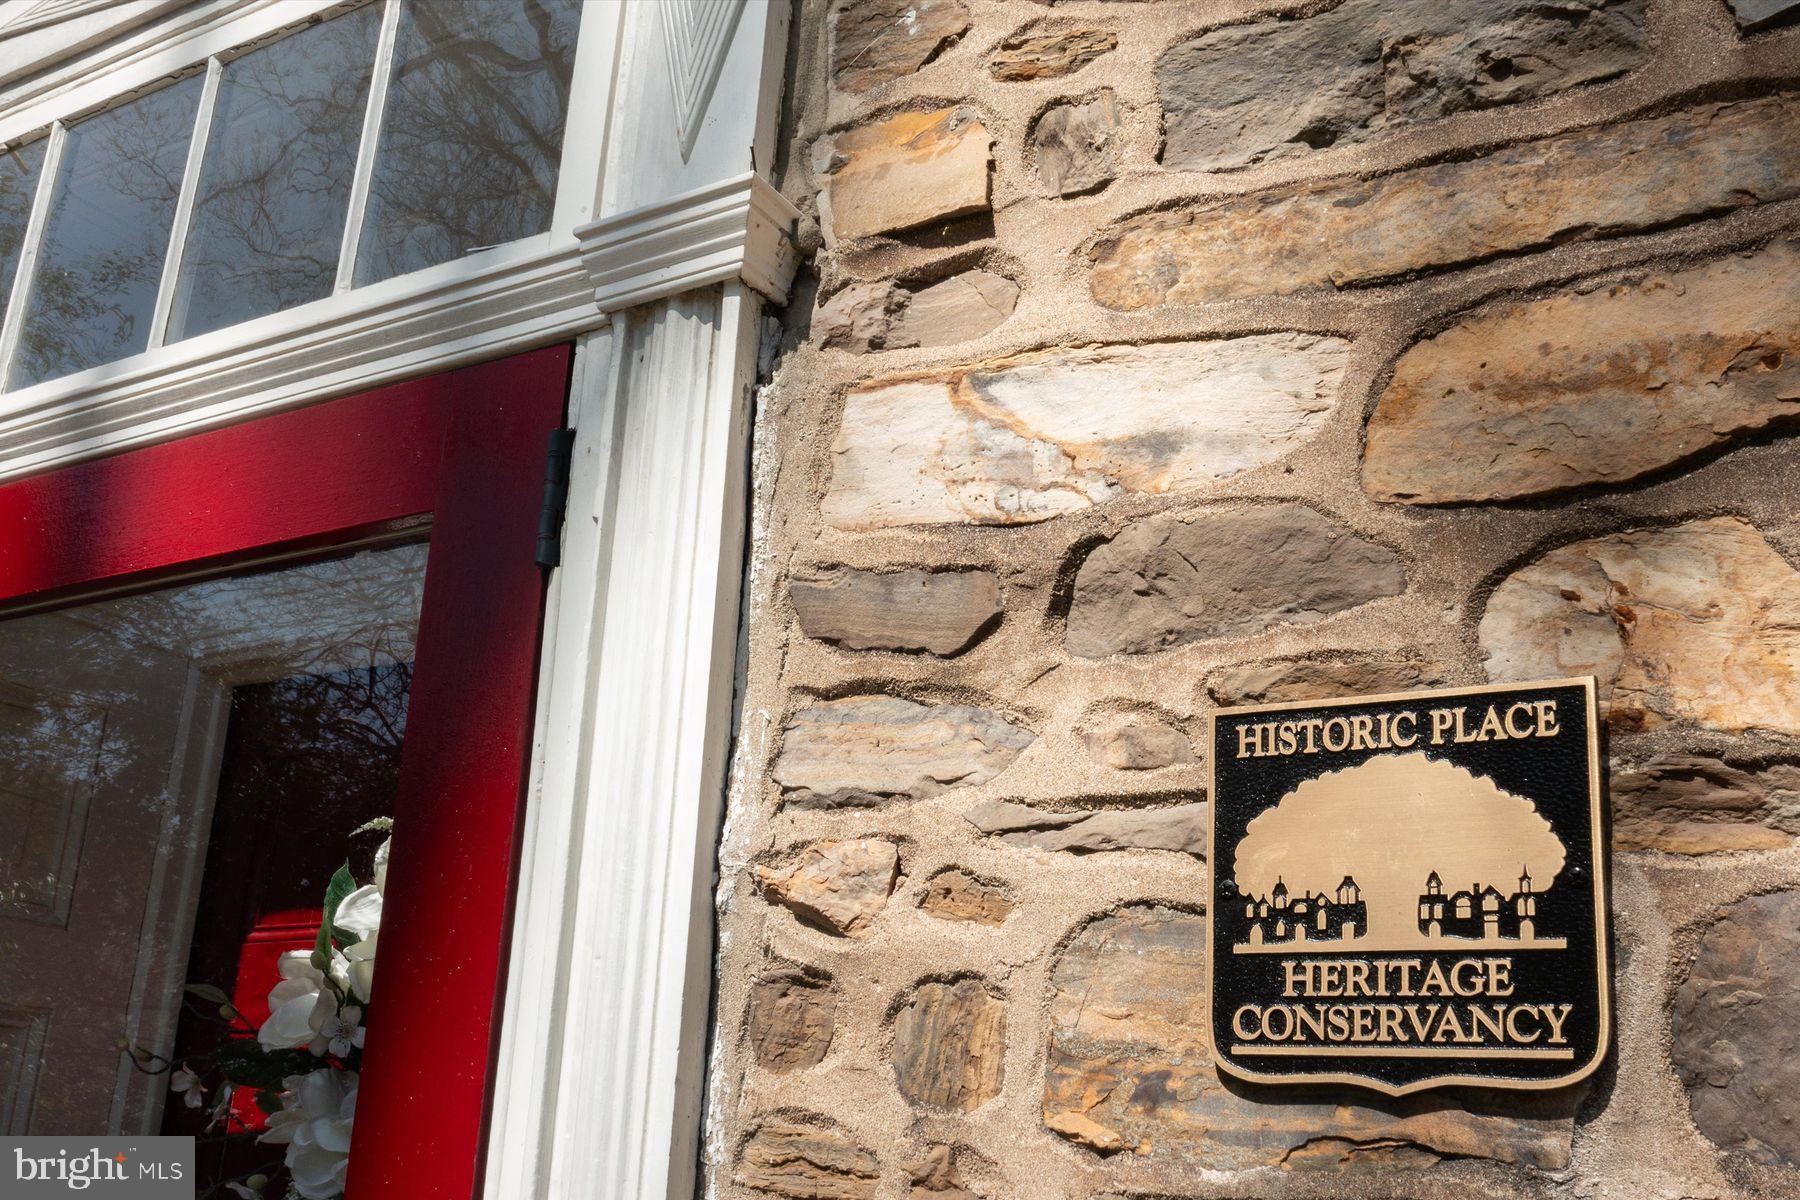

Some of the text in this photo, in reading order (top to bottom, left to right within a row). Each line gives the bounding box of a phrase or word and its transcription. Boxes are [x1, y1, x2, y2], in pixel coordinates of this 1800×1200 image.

[1236, 701, 1561, 759] HISTORIC PLACE
[1282, 958, 1515, 998] HERITAGE
[1232, 1003, 1573, 1044] CONSERVANCY
